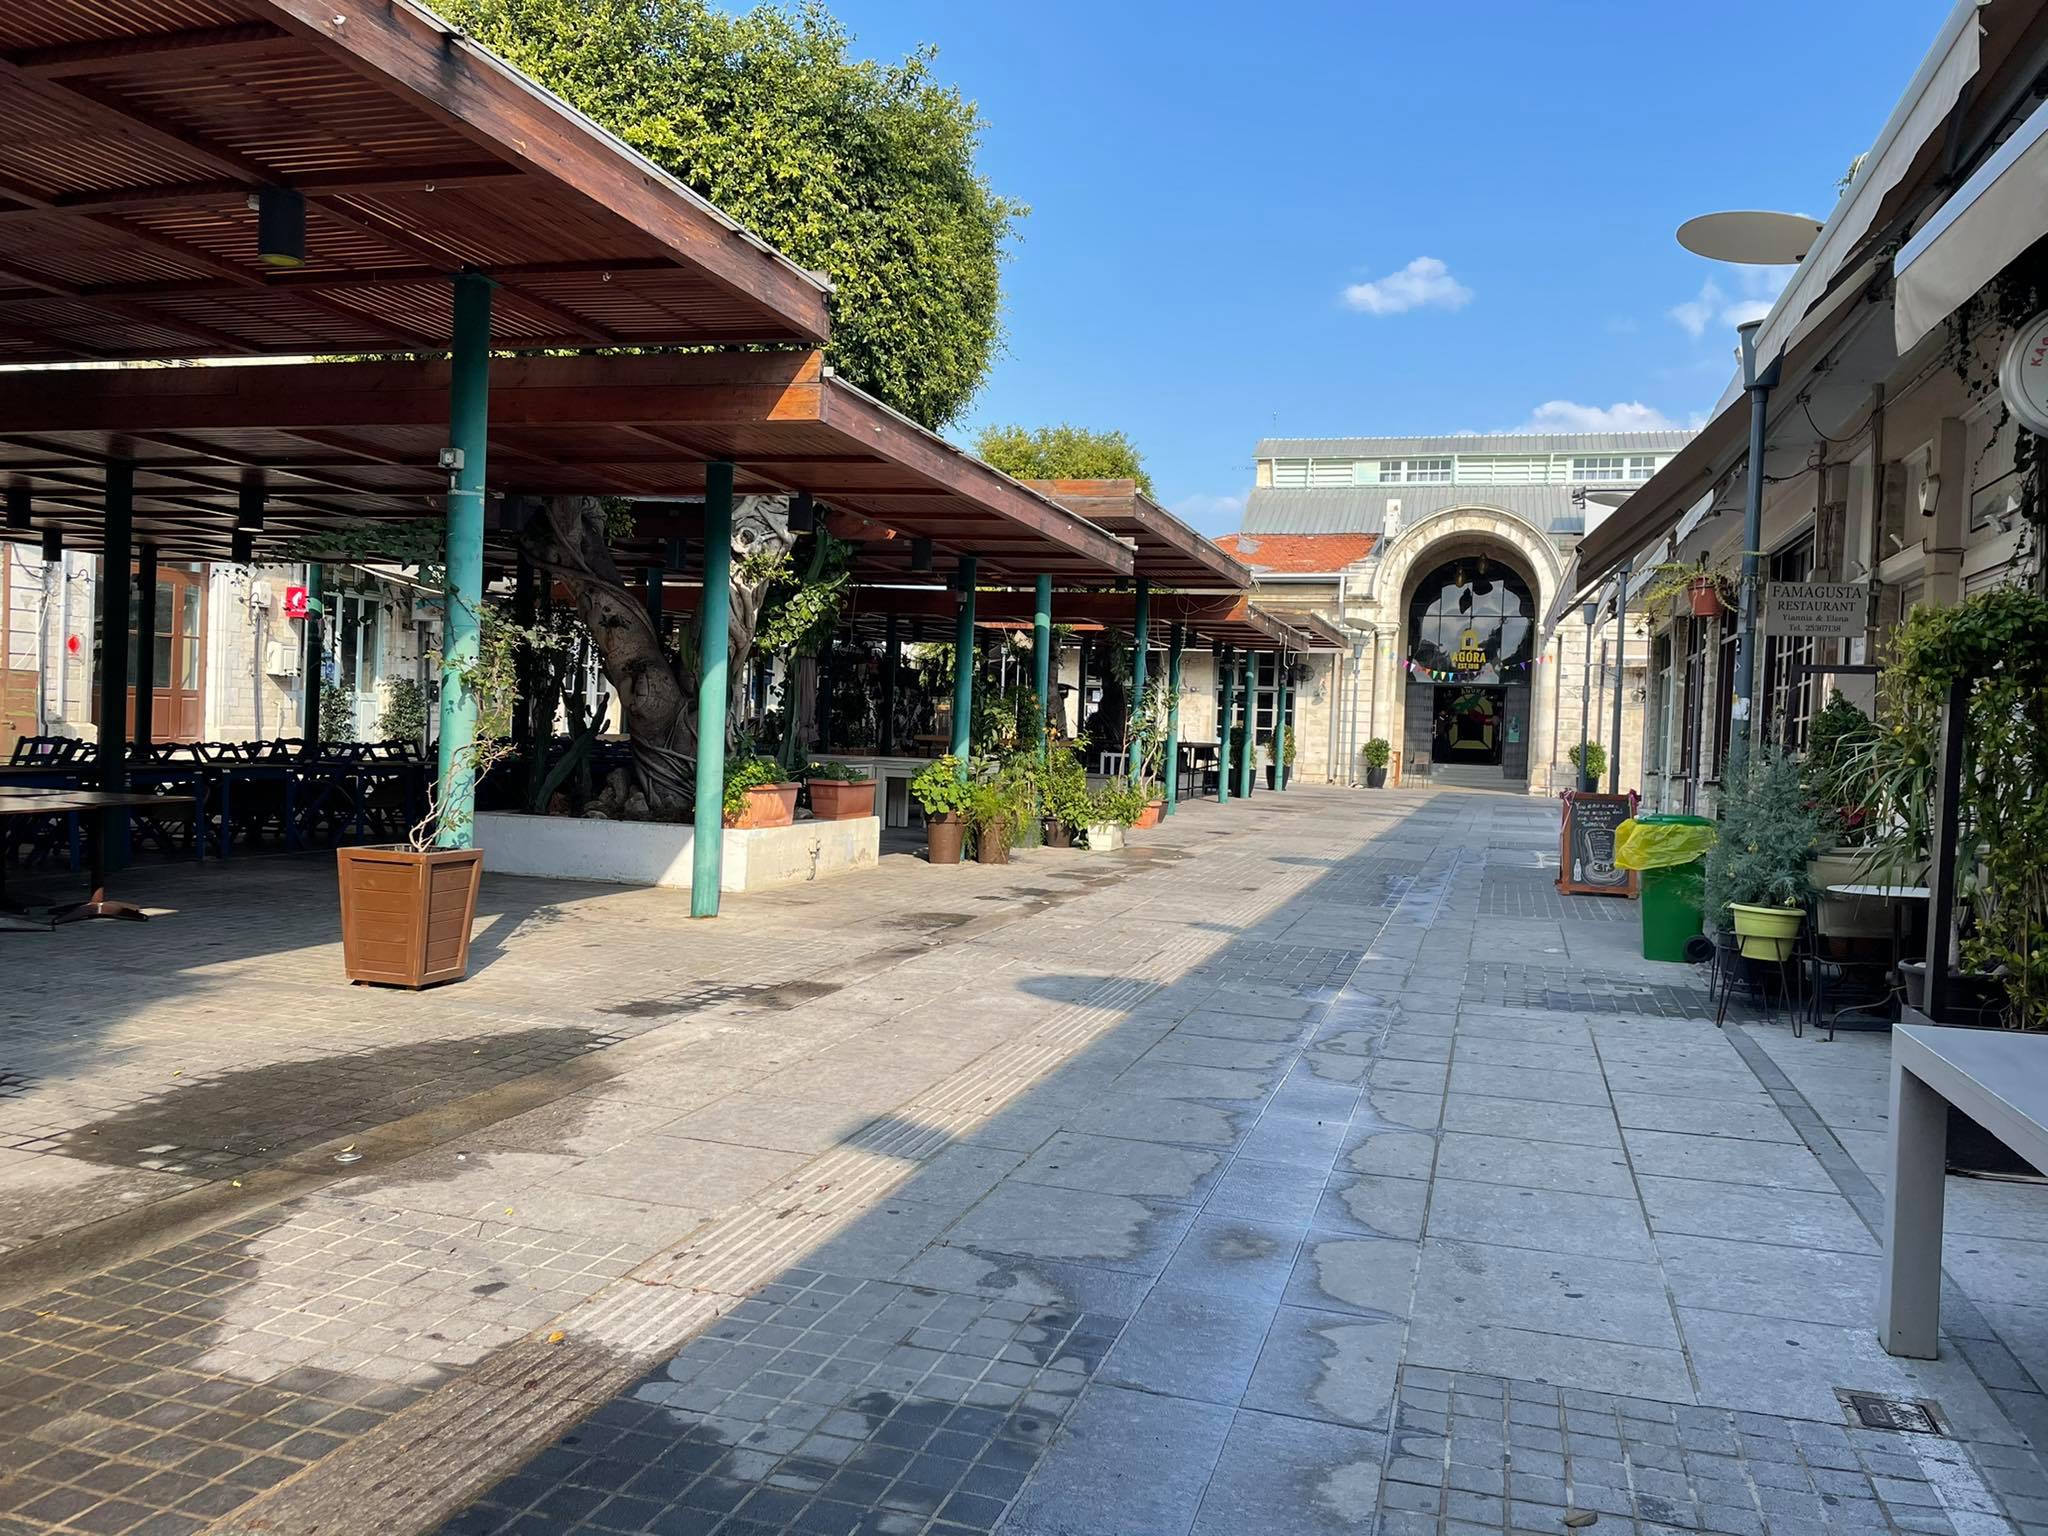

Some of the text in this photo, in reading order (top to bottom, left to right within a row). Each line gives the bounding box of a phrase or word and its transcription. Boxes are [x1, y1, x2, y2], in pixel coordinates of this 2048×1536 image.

[1772, 586, 1862, 599] FAMAGUSTA
[1777, 600, 1857, 612] RESTAURANT
[1815, 614, 1823, 622] &
[1826, 614, 1849, 622] Elena
[1789, 624, 1803, 632] Tel.
